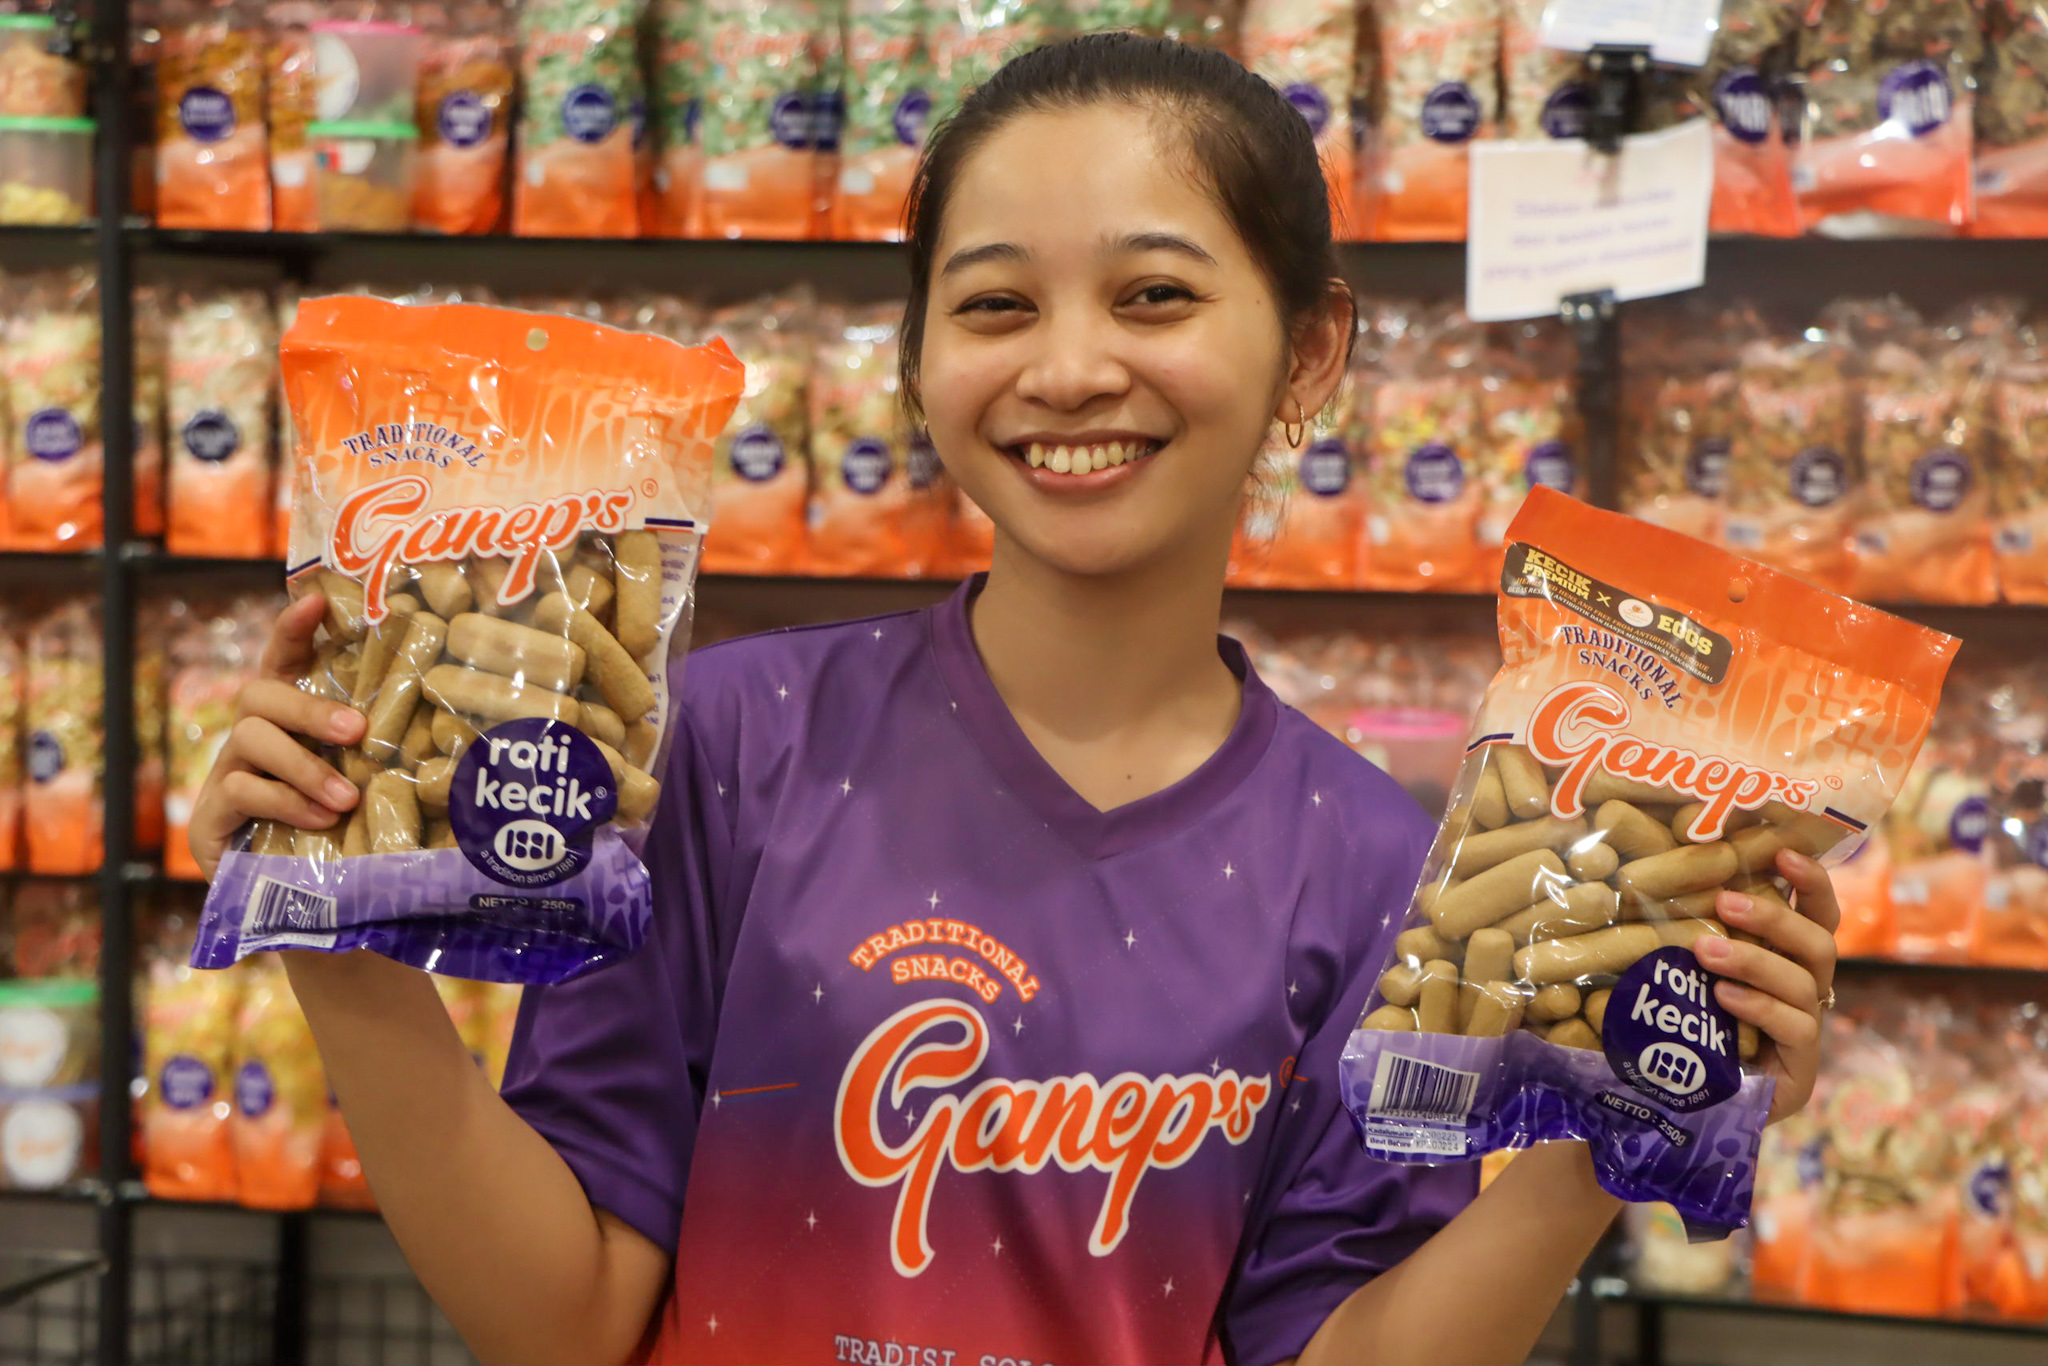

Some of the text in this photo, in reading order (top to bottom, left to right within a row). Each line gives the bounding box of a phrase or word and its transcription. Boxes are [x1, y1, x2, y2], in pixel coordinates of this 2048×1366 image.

[369, 446, 454, 470] SNACKS
[330, 474, 637, 626] Ganep's
[1522, 562, 1589, 600] PREMIUM
[1526, 548, 1592, 592] KECIK
[1657, 614, 1713, 656] EGGS
[1553, 594, 1590, 617] ANTIBIOTIK
[1590, 613, 1603, 625] DAN
[1604, 620, 1625, 637] HANYA
[1625, 632, 1670, 658] MENGUNAKAN
[1670, 653, 1690, 670] PAKAN
[1559, 588, 1578, 603] HENS
[1577, 600, 1593, 613] AND
[1593, 608, 1612, 622] FREE
[1612, 618, 1634, 633] FROM
[1634, 628, 1679, 654] ANTIBIOTICS
[1559, 624, 1682, 709] TRADITIONAL
[1578, 650, 1653, 700] SNACKS
[488, 733, 571, 774] roti
[1526, 680, 1820, 843] Ganep's
[475, 767, 593, 821] kecik
[486, 855, 526, 884] tradition
[526, 870, 556, 883] since
[556, 854, 578, 874] 1881
[849, 918, 1041, 1003] TRADITIONAL
[891, 955, 1002, 1003] SNACKS
[1653, 957, 1708, 1006] roti
[1630, 983, 1727, 1057] kecik
[1602, 1093, 1650, 1119] NETTO
[1659, 1119, 1687, 1146] 250g
[1658, 1091, 1686, 1107] since
[1688, 1088, 1710, 1105] 1881
[834, 998, 1271, 1278] Ganep's
[834, 1334, 956, 1366] TRADISI
